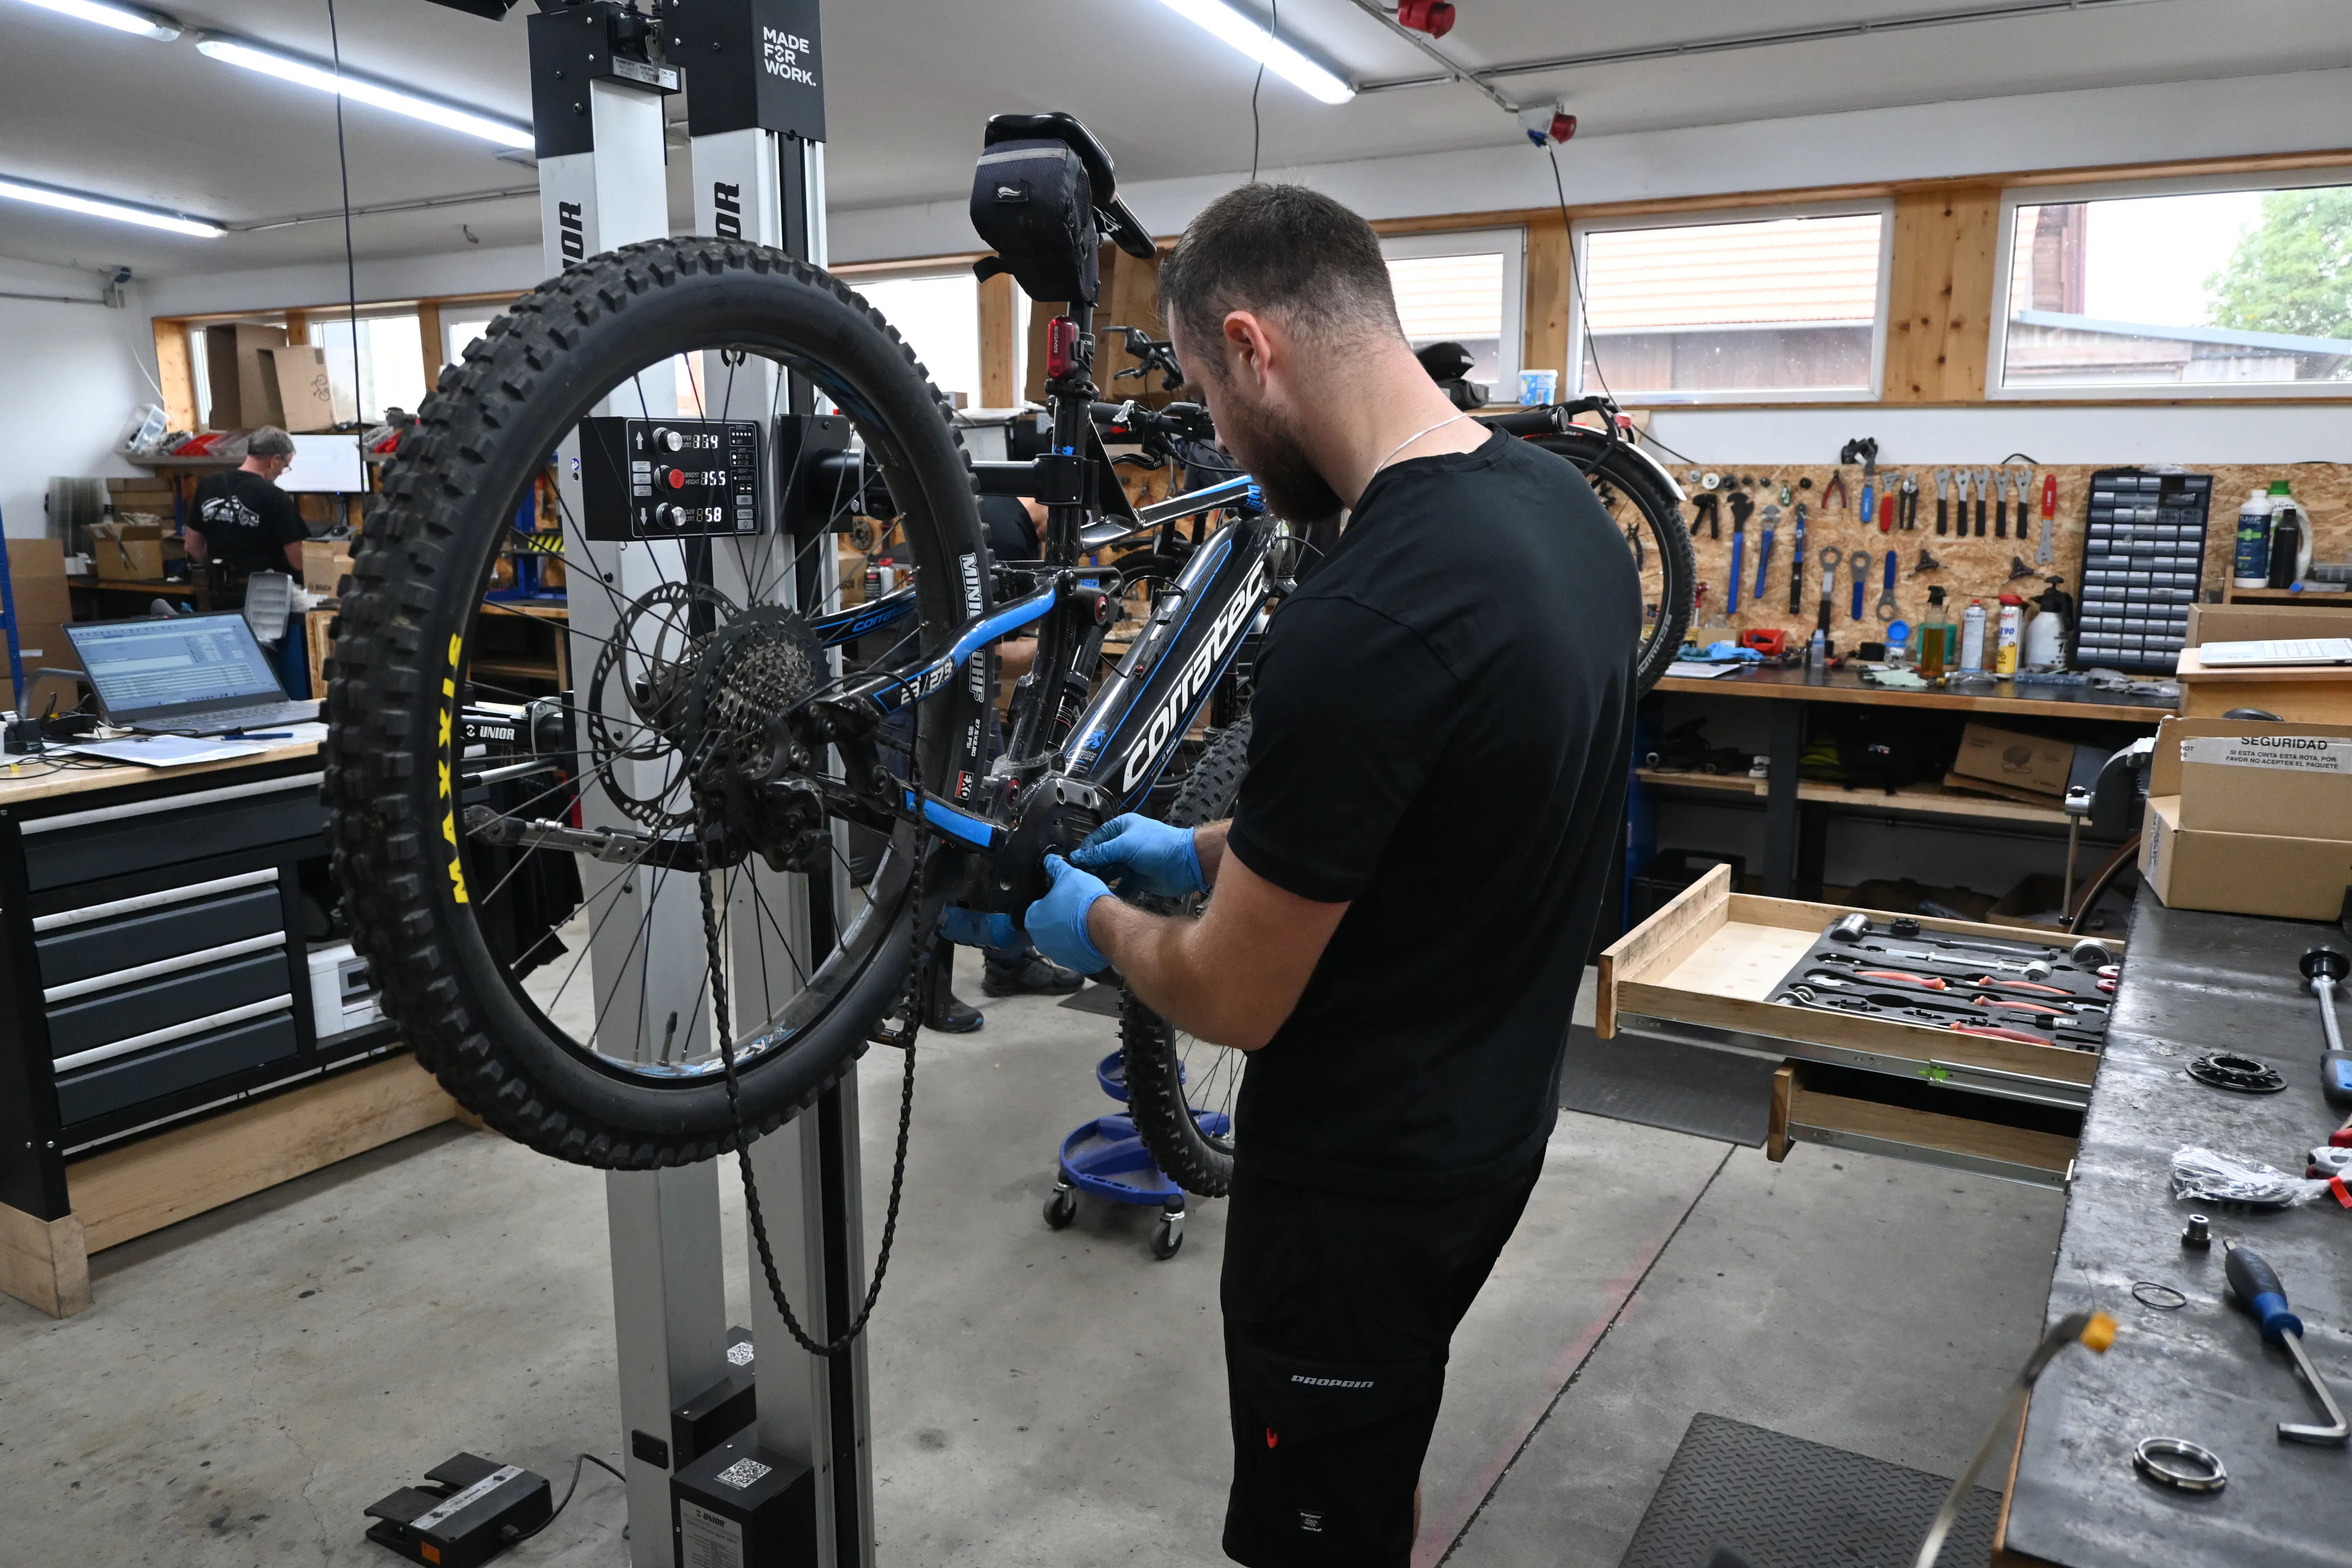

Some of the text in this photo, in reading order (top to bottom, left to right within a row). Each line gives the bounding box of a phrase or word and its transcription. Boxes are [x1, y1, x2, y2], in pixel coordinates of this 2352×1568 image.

[763, 27, 809, 54] MADE
[764, 43, 796, 65] FOR
[764, 58, 817, 87] WORK.
[704, 471, 726, 485] 155
[705, 507, 721, 522] 58
[969, 649, 985, 703] DHF
[1123, 560, 1265, 793] corratec
[479, 725, 515, 740] UNIOR
[968, 726, 974, 736] 35
[1166, 737, 1177, 755] BOSCH
[2240, 737, 2328, 750] SEGURIDAD
[438, 632, 469, 904] MAXXIS
[961, 774, 972, 799] EXO
[1291, 1375, 1374, 1388] PROPAIN
[703, 1513, 724, 1527] UNIOR
